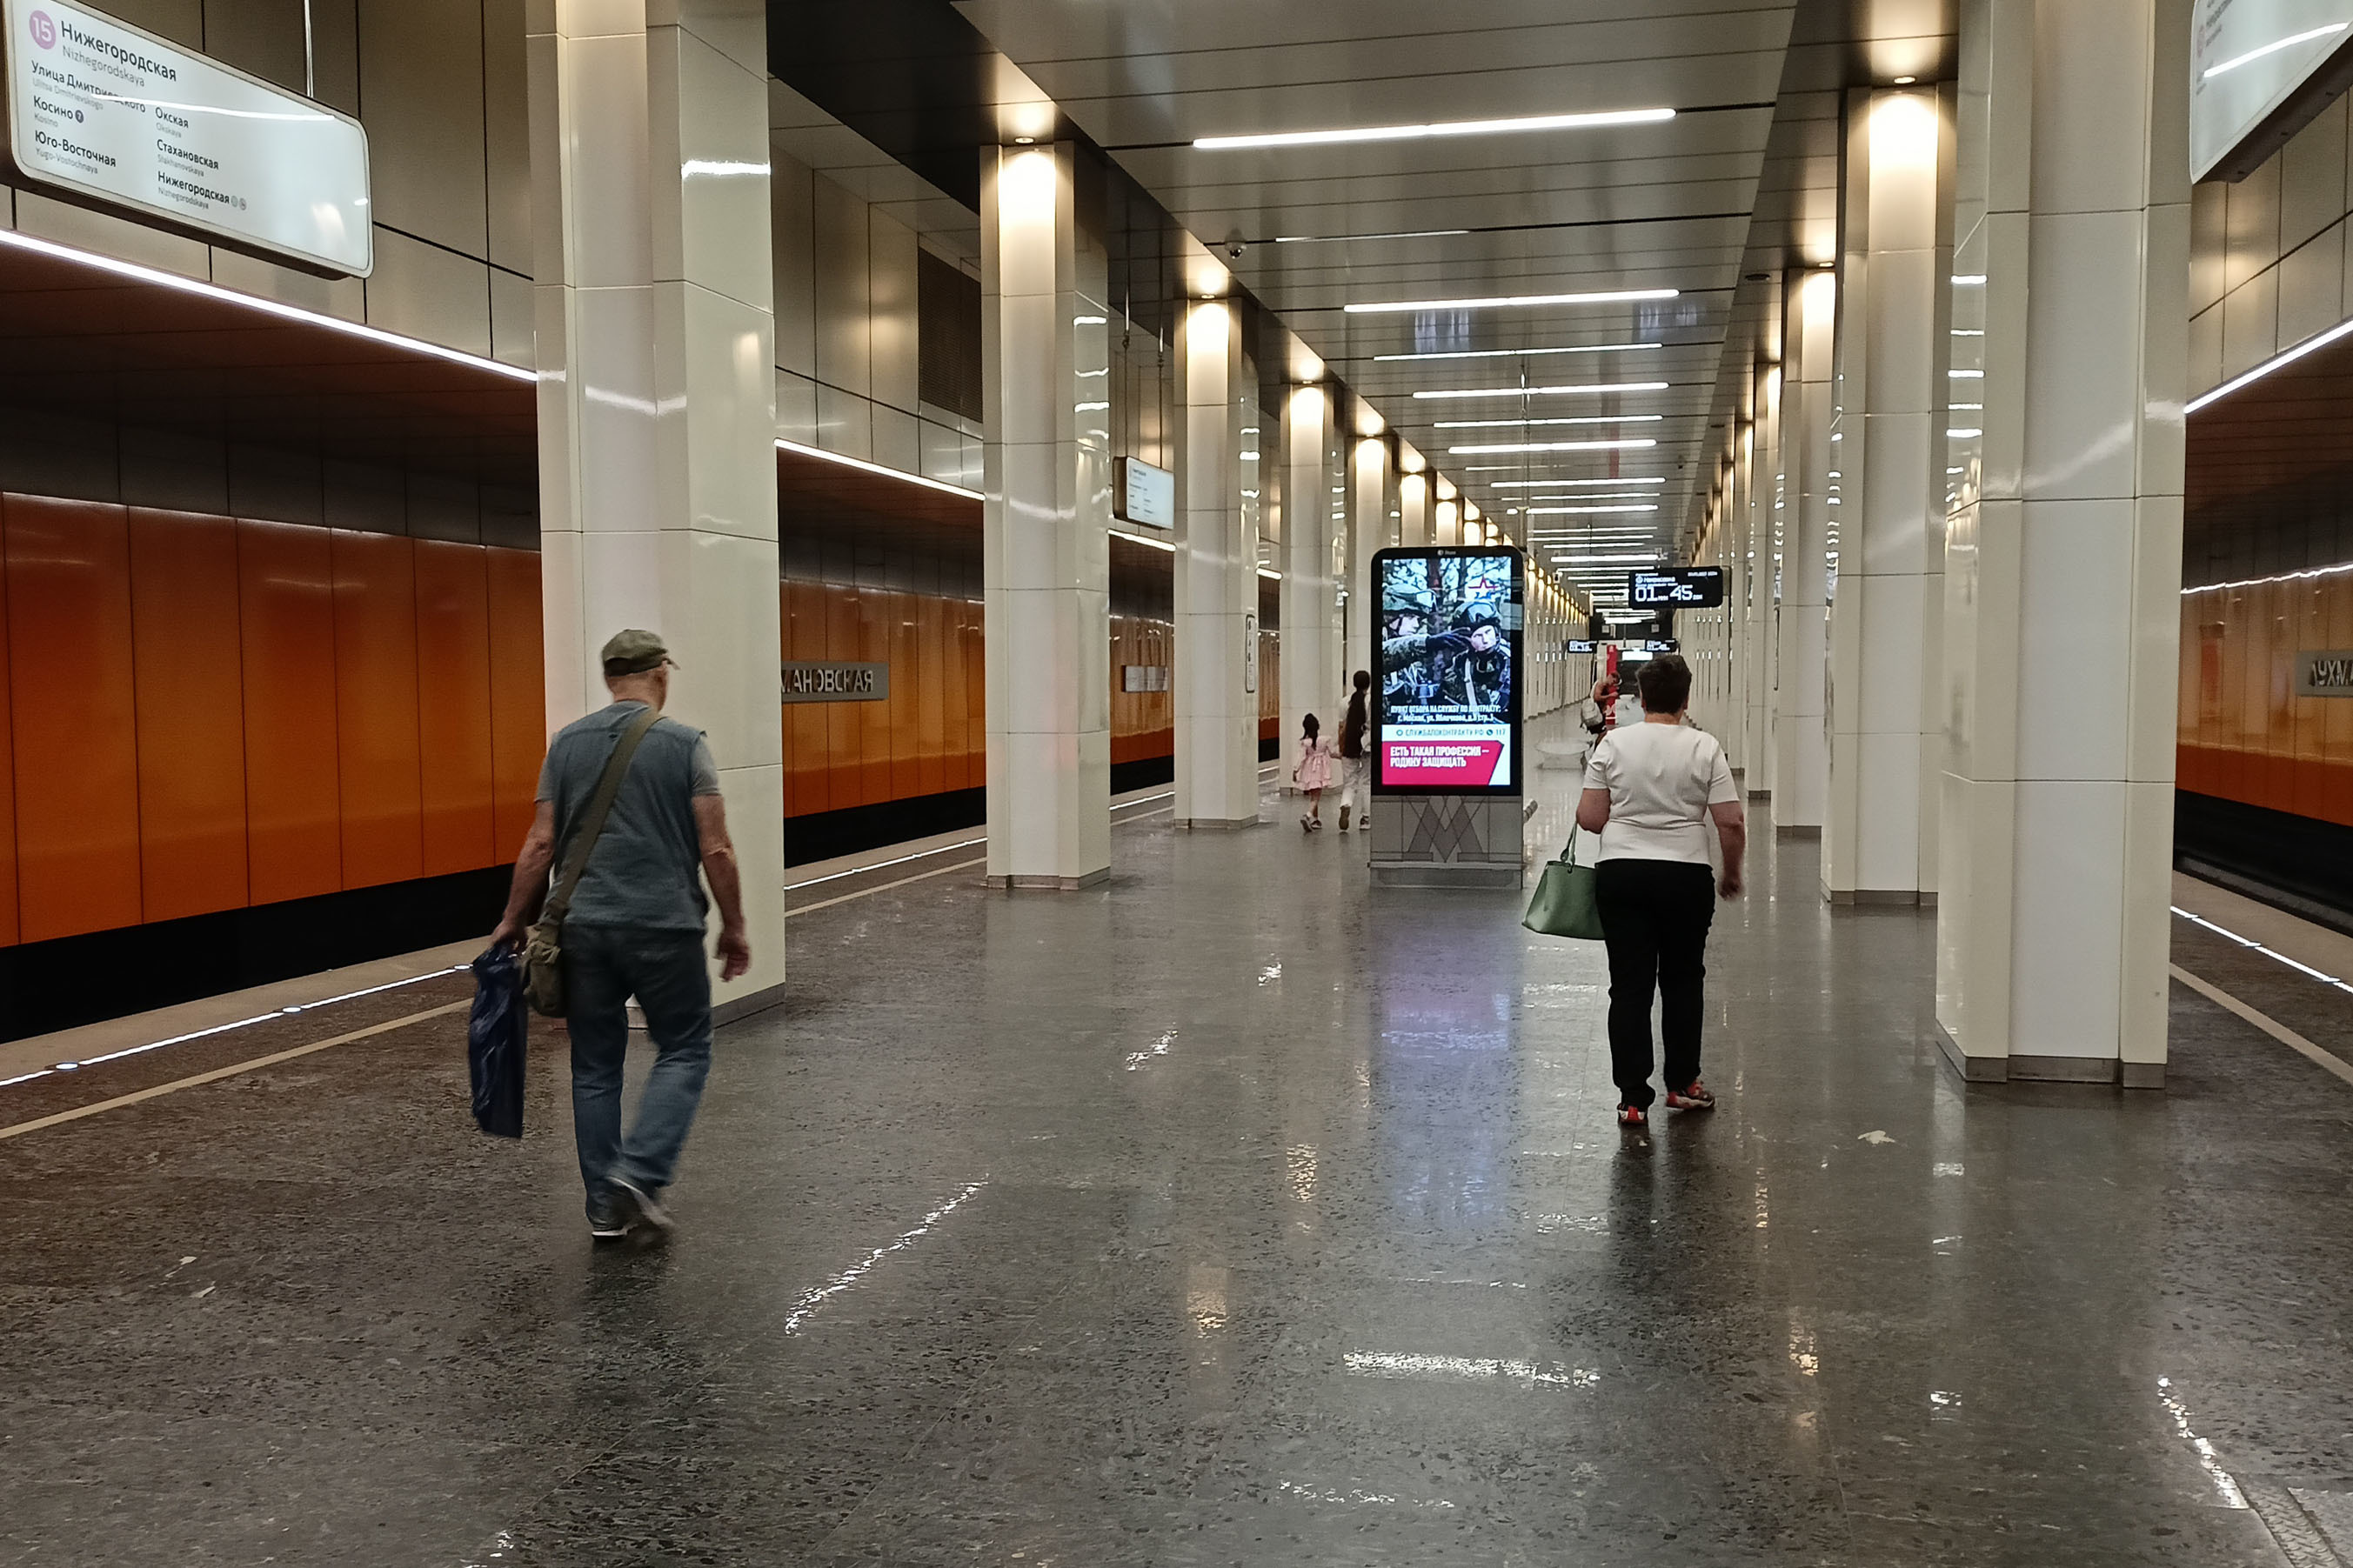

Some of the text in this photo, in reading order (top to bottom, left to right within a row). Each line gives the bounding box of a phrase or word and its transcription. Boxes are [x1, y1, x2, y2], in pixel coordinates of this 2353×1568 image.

[32, 17, 177, 82] 15 Нижегородская
[63, 45, 145, 88] Nizhegorodskaya
[31, 60, 146, 113] Улица Дмитрикого
[33, 95, 74, 120] Косино
[155, 106, 189, 129] Окская
[35, 130, 117, 168] Юго-Восточная
[157, 138, 219, 170] Стахановская
[157, 170, 230, 204] Нижегородская
[1635, 586, 1658, 602] 01
[1670, 584, 1694, 601] 45
[1390, 746, 1409, 757] ЕСТЬ
[1409, 746, 1435, 757] ТАКАЯ
[1435, 746, 1481, 757] ПРОФЕССИЯ
[1390, 757, 1467, 767] РОДИНУ ЗАЩИЩАТЬ
